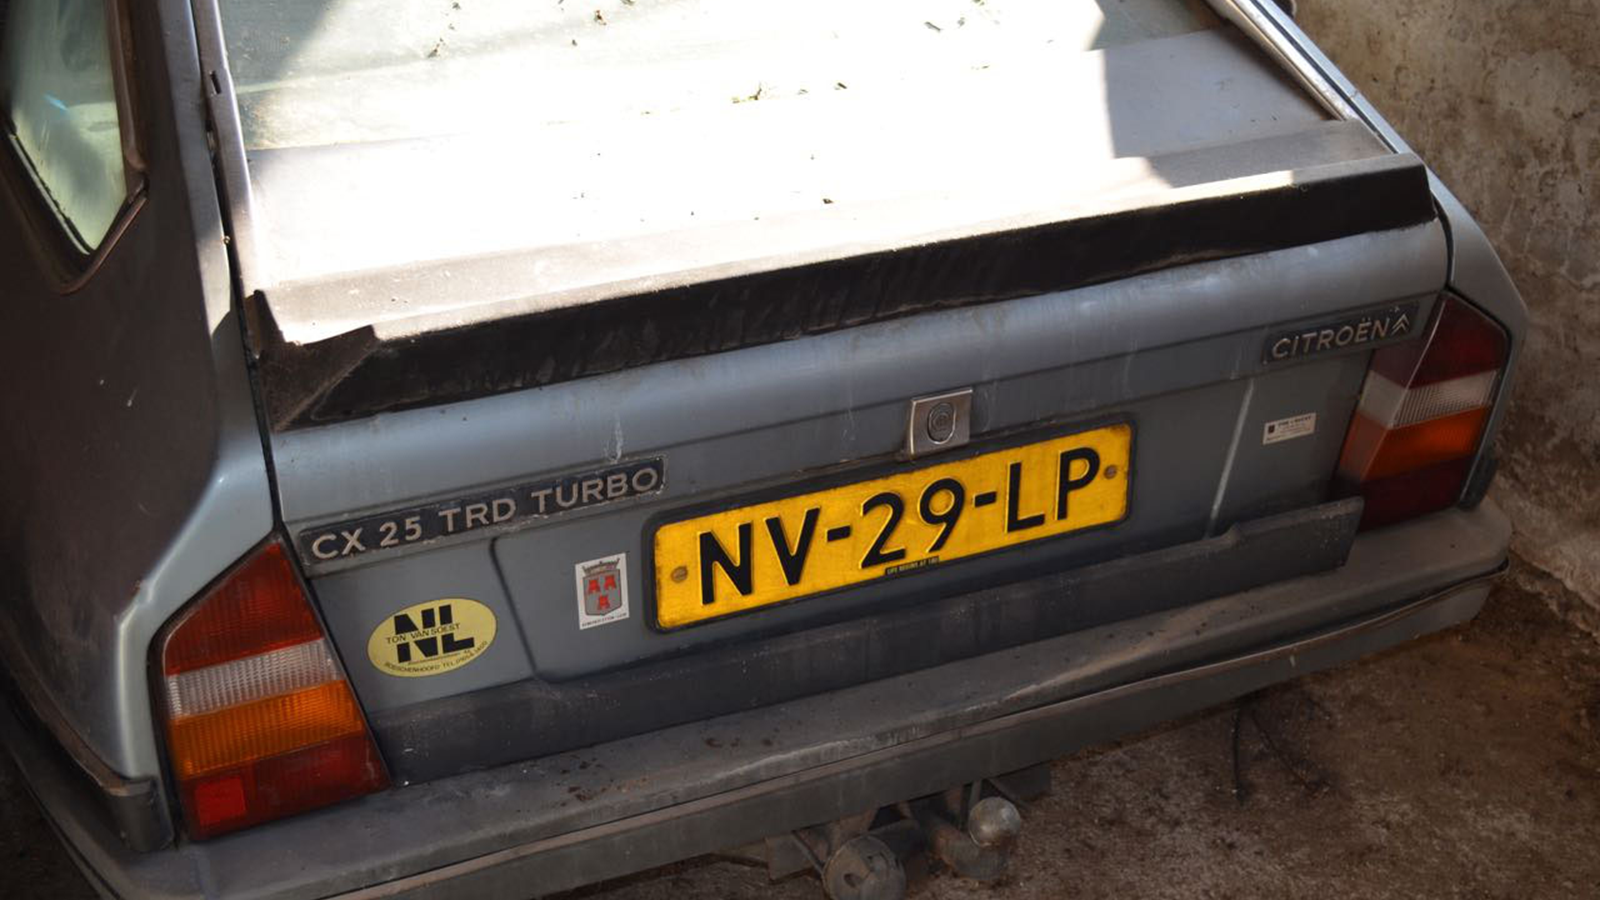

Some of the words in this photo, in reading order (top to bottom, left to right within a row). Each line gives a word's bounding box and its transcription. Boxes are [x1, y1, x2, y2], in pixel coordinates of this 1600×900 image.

[1272, 316, 1390, 359] CITROËN
[311, 527, 367, 561] CX
[379, 516, 422, 548] 25
[438, 498, 517, 533] TRD
[530, 467, 658, 514] TURBO
[698, 446, 1102, 606] NV-29-LP
[385, 633, 406, 645] TON
[410, 629, 430, 640] VAN
[430, 623, 461, 636] SOEST
